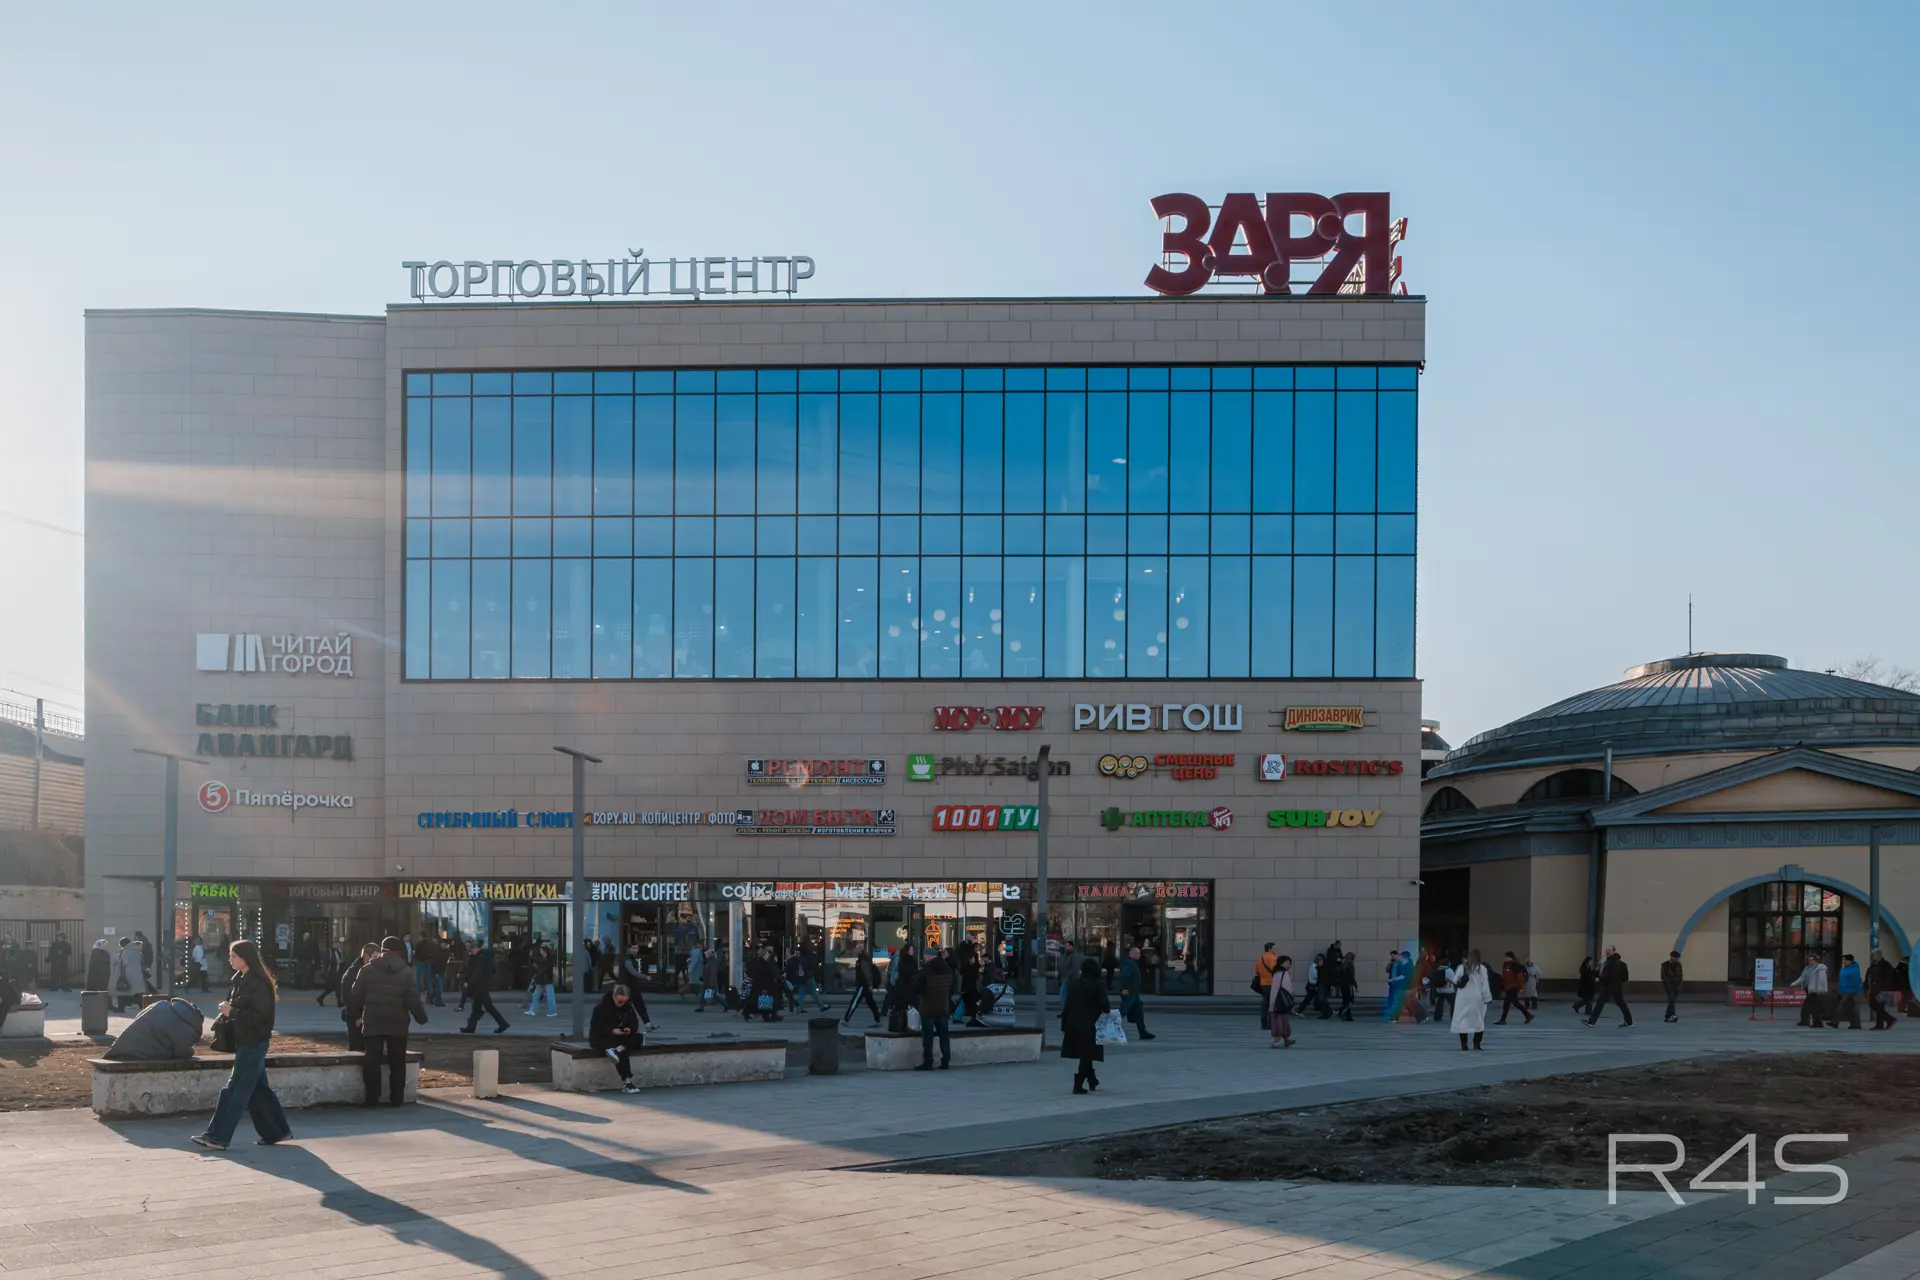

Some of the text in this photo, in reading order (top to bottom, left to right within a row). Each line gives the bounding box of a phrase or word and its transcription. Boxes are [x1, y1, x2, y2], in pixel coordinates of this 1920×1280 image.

[1144, 191, 1390, 296] ЗАРЯ
[402, 247, 816, 300] ТОРГОВЫЙ ЦЕНТР
[271, 633, 351, 654] ЧИТАЙ
[270, 654, 353, 677] ГОРОД
[196, 703, 278, 728] БАНК
[1073, 703, 1243, 731] РИВ ГОШ
[1287, 708, 1362, 727] ДИНОЗАВРИК
[196, 733, 354, 761] АВАНГАРД
[767, 758, 866, 777] РЕМОНТ
[1155, 753, 1236, 767] СМЕШНЫЕ
[1295, 759, 1404, 775] ROSTIC'S
[1172, 767, 1218, 781] ЦЕНЫ
[235, 788, 354, 812] Пятёрочка
[417, 809, 518, 828] СЕРЕБРЯНЫЙ
[593, 812, 636, 825] COPY.RU
[641, 811, 700, 826] КОПИЦЕНТР
[708, 812, 736, 826] ФОТО
[756, 809, 876, 826] ДОМ БЫТА
[1131, 810, 1207, 827] АПТЕКА
[190, 883, 240, 898] ТАБАК
[288, 884, 381, 899] ТОРГОВЫЙ ЦЕНТР
[399, 882, 469, 899] ШАУРМА
[483, 882, 558, 899] НАПИТКИ
[592, 882, 688, 901] ONE PRICE COFFEE
[873, 887, 902, 899] TEA
[1002, 883, 1021, 900] t2
[1078, 884, 1209, 898] ПАША ДОНЕР
